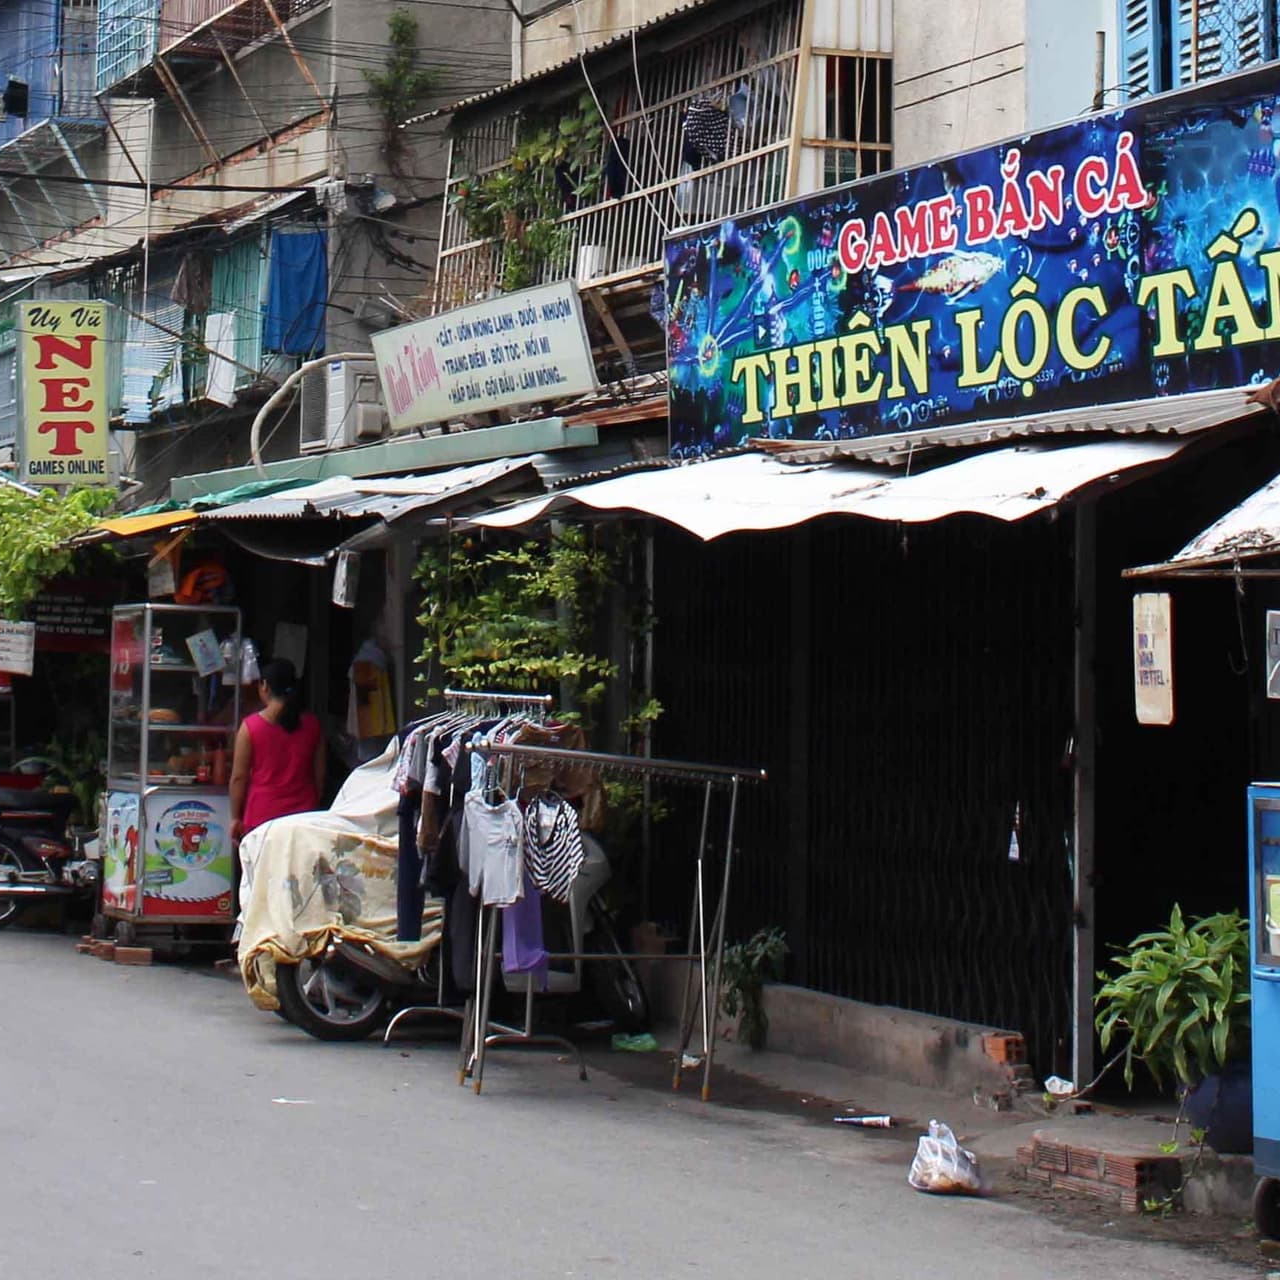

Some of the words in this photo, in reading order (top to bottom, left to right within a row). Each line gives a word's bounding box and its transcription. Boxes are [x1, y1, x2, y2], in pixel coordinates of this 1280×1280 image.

[837, 193, 959, 274] GAME
[964, 148, 1064, 245] BẮN
[1074, 131, 1149, 218] CÁ
[28, 306, 61, 331] Uy
[70, 307, 101, 328] Vũ
[731, 309, 933, 425] THIÊN
[954, 274, 1112, 398] LỘC
[32, 334, 98, 456] NET
[29, 460, 65, 475] GAMES
[68, 459, 105, 475] ONLINE
